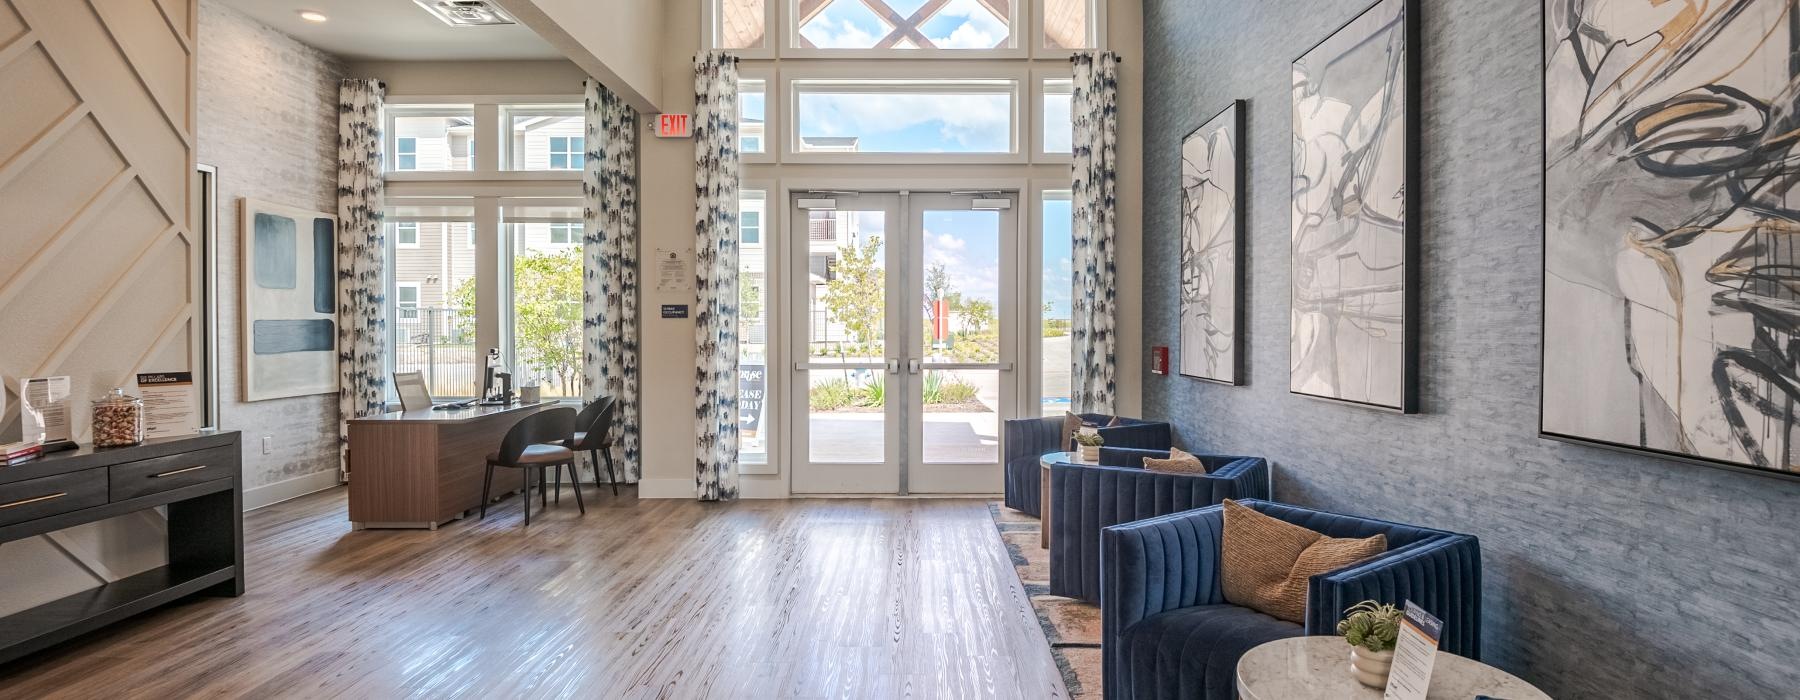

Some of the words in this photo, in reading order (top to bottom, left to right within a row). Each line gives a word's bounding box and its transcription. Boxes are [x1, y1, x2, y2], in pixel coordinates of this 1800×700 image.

[661, 114, 687, 137] EXIT
[739, 389, 762, 399] EASE
[739, 400, 761, 410] DAY
